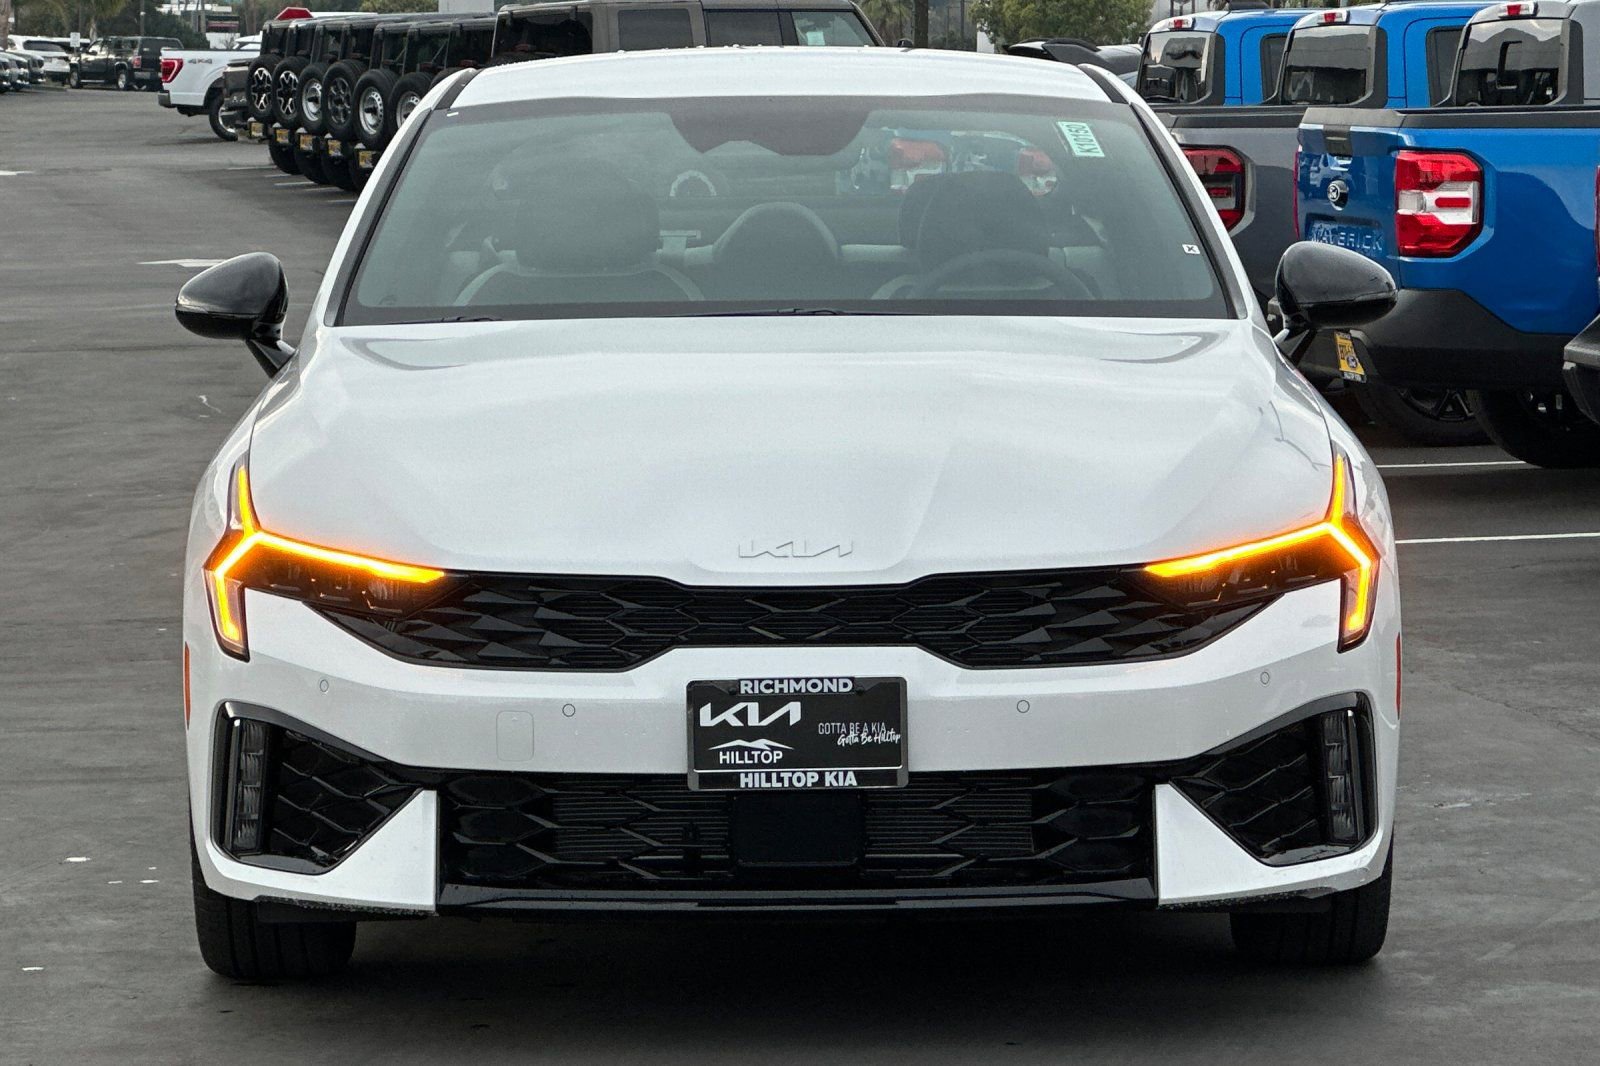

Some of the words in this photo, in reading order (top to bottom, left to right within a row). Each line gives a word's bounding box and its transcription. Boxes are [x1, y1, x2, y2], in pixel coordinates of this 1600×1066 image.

[740, 678, 853, 694] RICHMOND
[699, 701, 802, 727] KIA
[818, 722, 847, 735] GOTTA
[849, 722, 860, 734] BE
[862, 722, 869, 734] A
[871, 722, 887, 733] KIA
[837, 731, 859, 747] Gotta
[860, 732, 873, 745] Be
[719, 750, 783, 764] HILLTOP
[740, 771, 819, 788] HILLTOP
[824, 770, 858, 787] KIA
